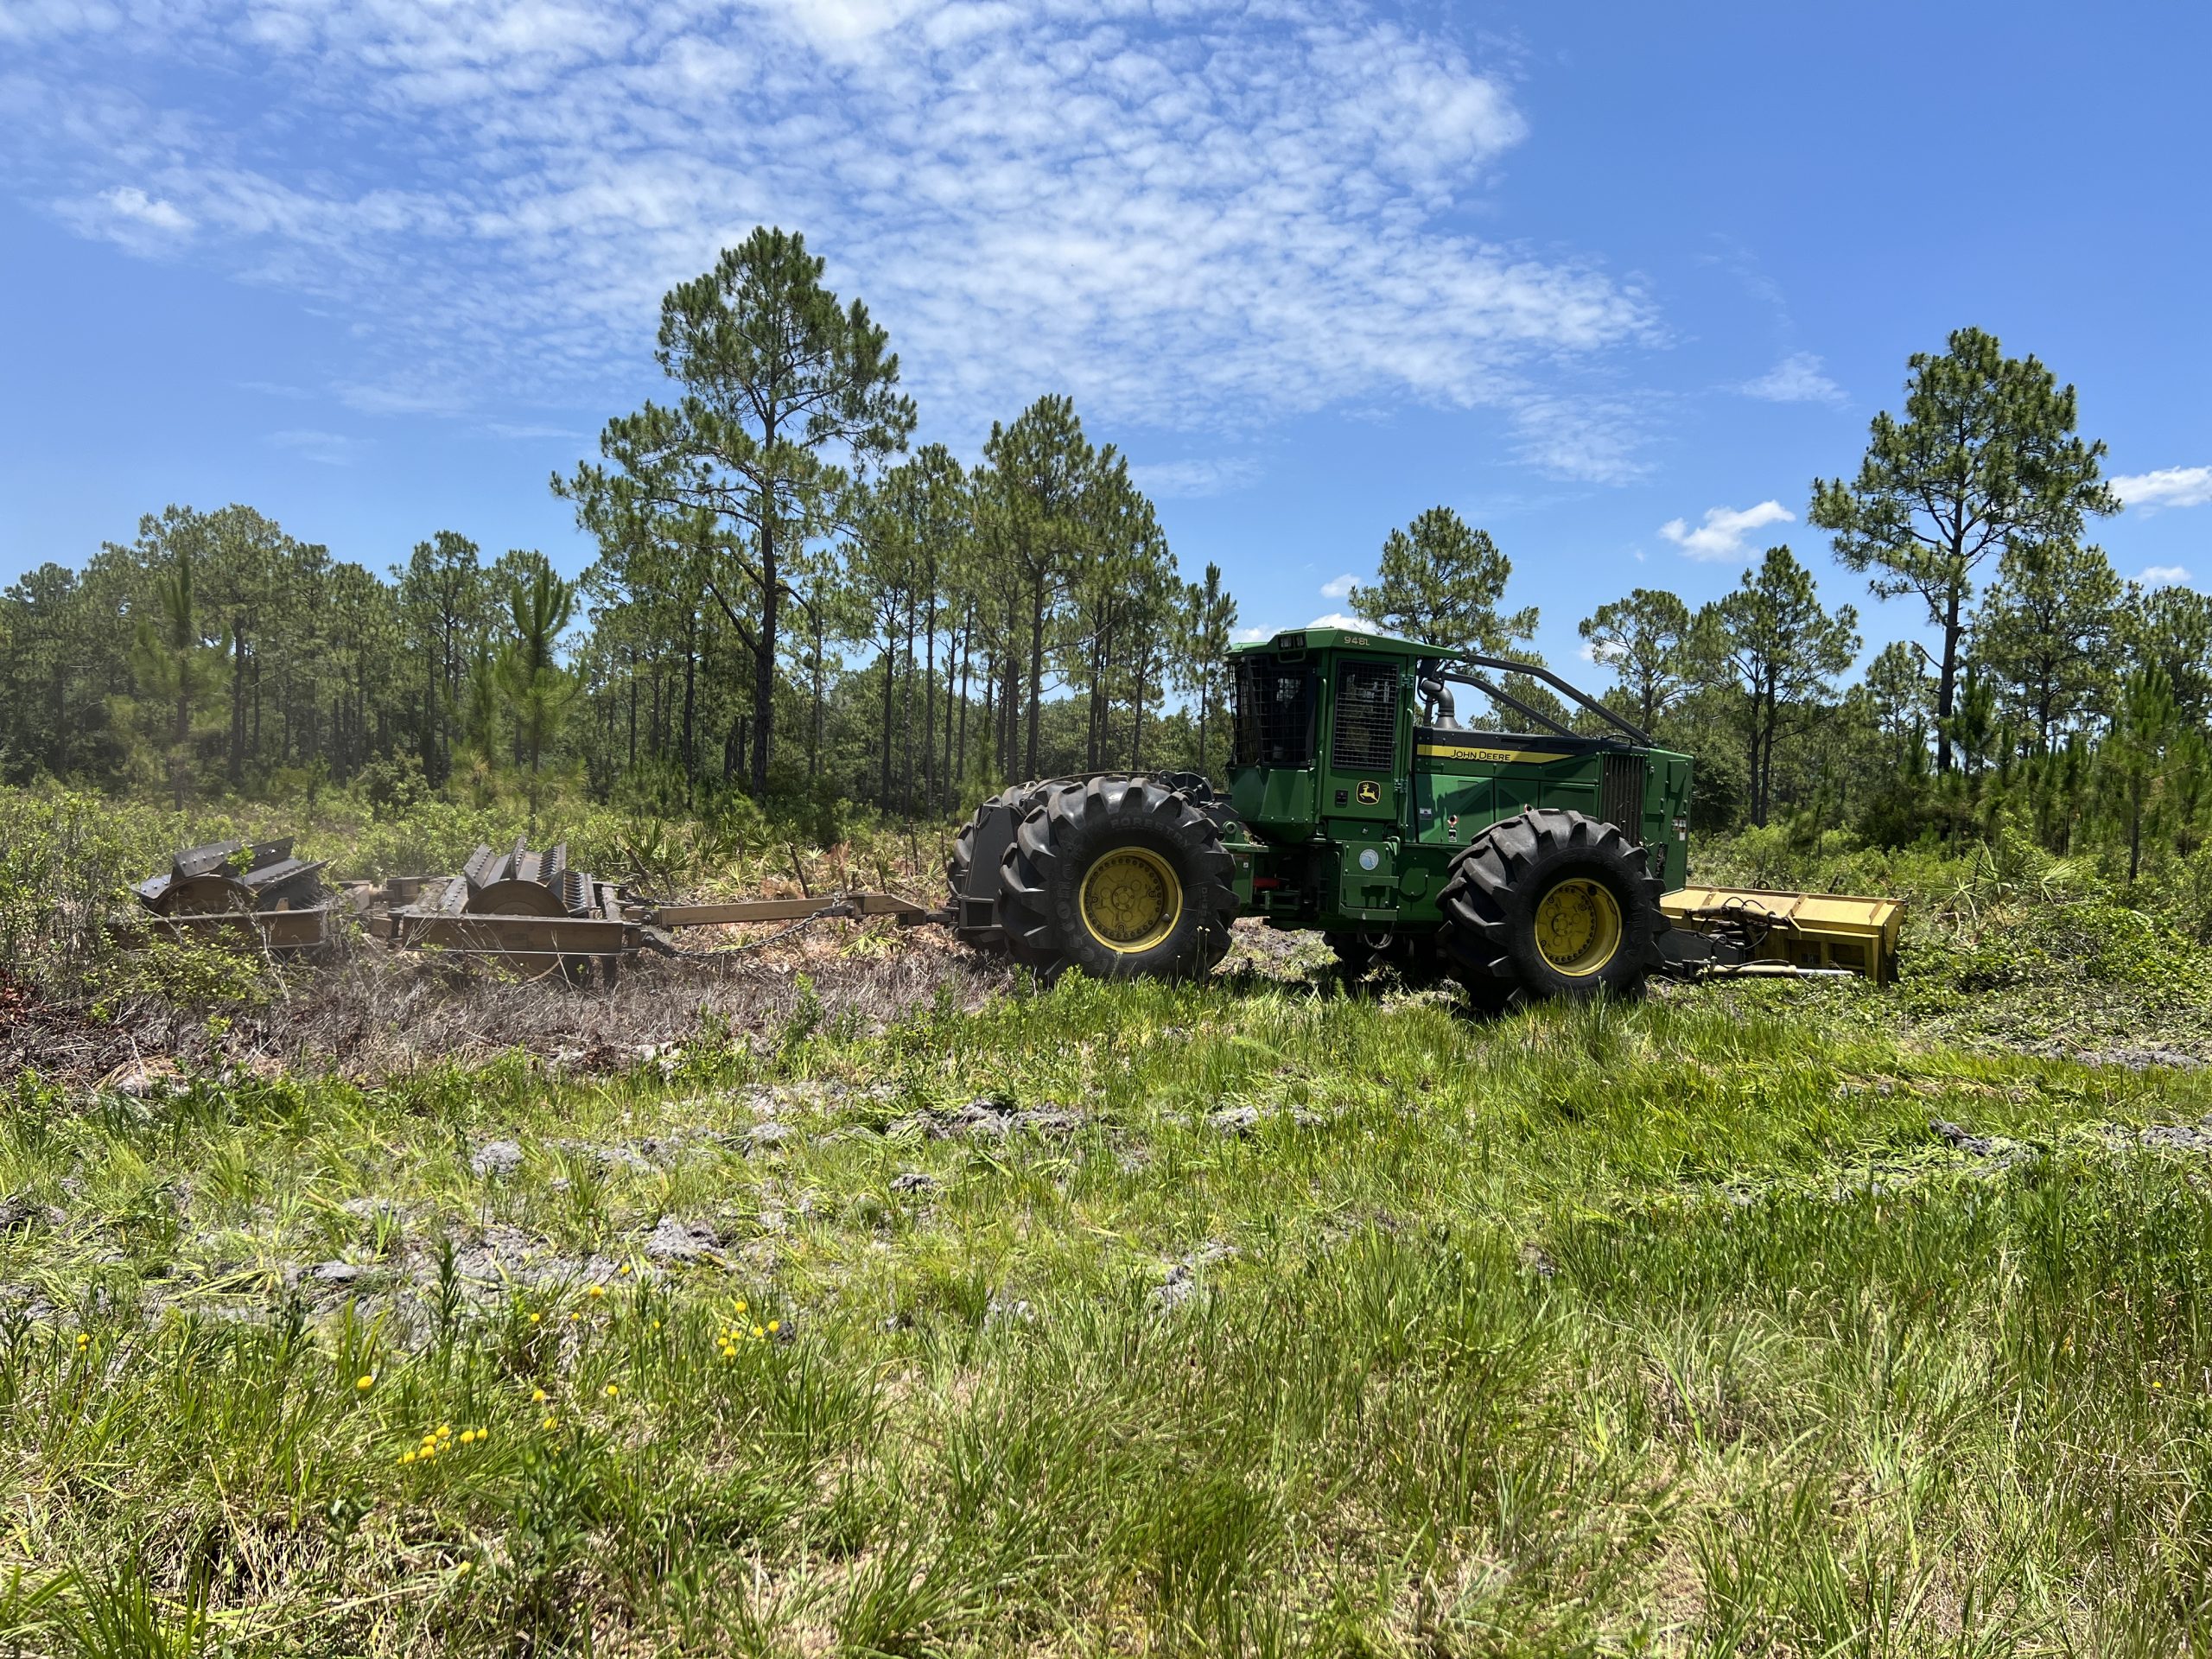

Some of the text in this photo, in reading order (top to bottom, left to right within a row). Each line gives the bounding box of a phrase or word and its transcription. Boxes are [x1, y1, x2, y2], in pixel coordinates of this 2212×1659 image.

[1344, 636, 1370, 646] 948L
[1451, 750, 1511, 761] JOHN DEERE
